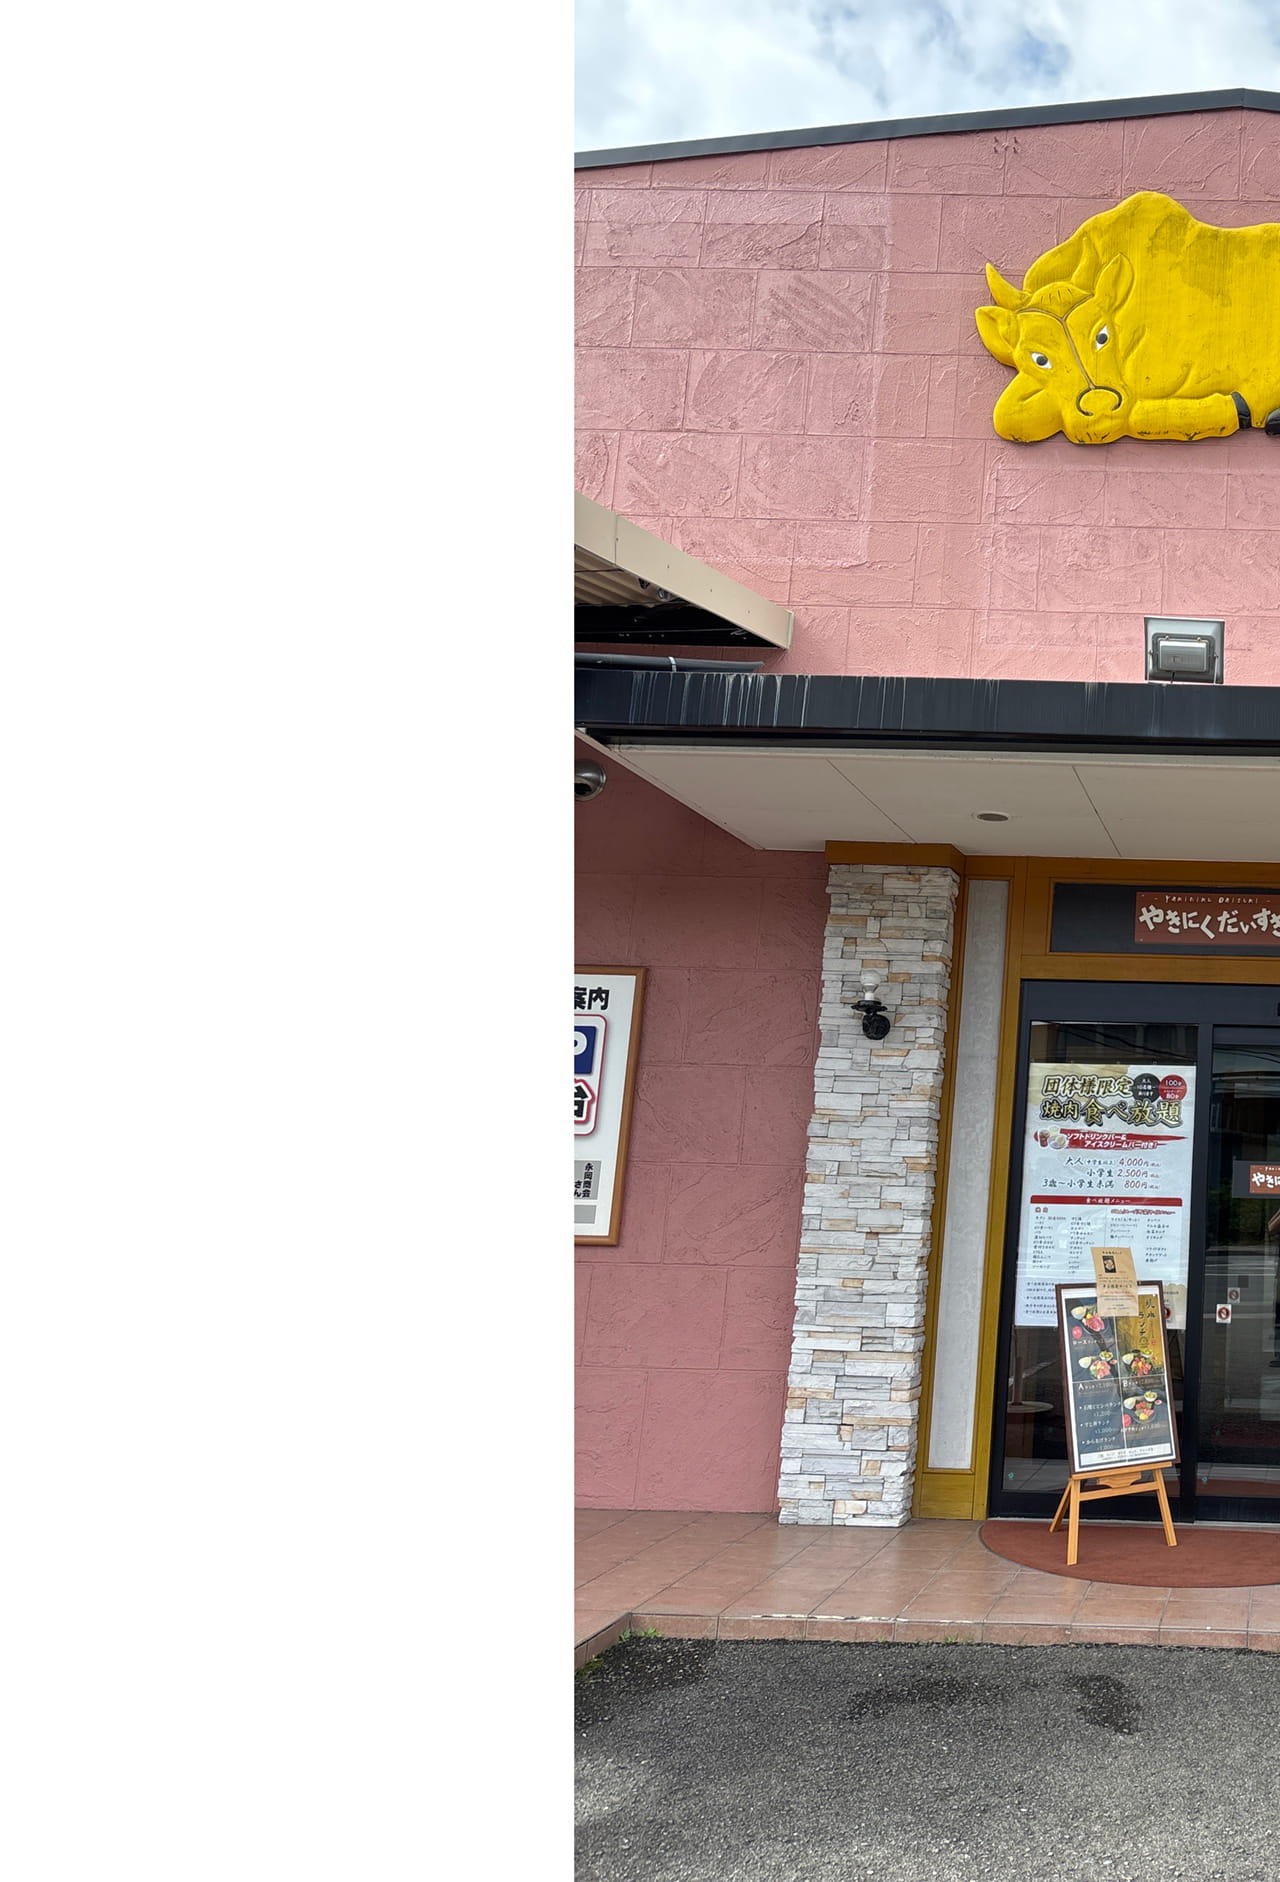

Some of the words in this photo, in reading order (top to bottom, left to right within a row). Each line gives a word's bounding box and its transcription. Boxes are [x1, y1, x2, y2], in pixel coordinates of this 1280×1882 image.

[1042, 1074, 1134, 1098] 団体様限定
[1040, 1099, 1183, 1128] 焼肉食べ放題
